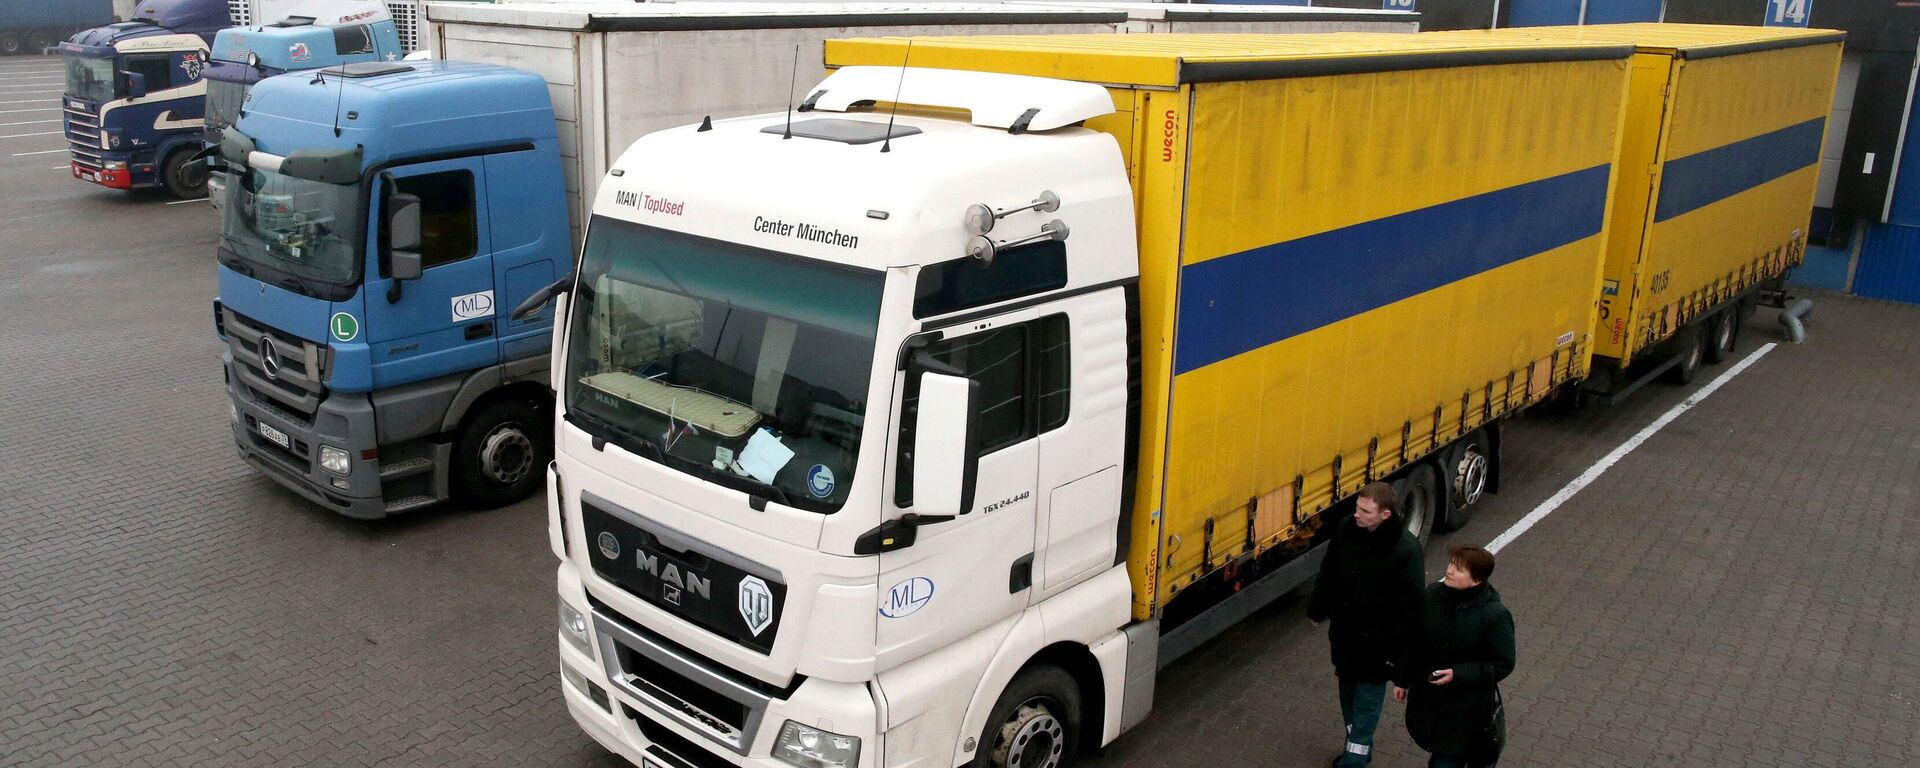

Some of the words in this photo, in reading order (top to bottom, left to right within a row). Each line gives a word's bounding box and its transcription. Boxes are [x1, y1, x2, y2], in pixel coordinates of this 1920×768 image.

[1774, 0, 1805, 23] 14
[1163, 110, 1175, 162] wecon
[615, 190, 637, 208] MAN
[643, 194, 685, 216] TopUsed
[753, 215, 795, 237] Center
[796, 222, 859, 249] München
[337, 318, 350, 336] L
[595, 391, 619, 409] MAN
[983, 501, 999, 515] TGX
[999, 491, 1030, 508] 24.440
[636, 548, 711, 601] MAN
[1148, 548, 1156, 595] wecon
